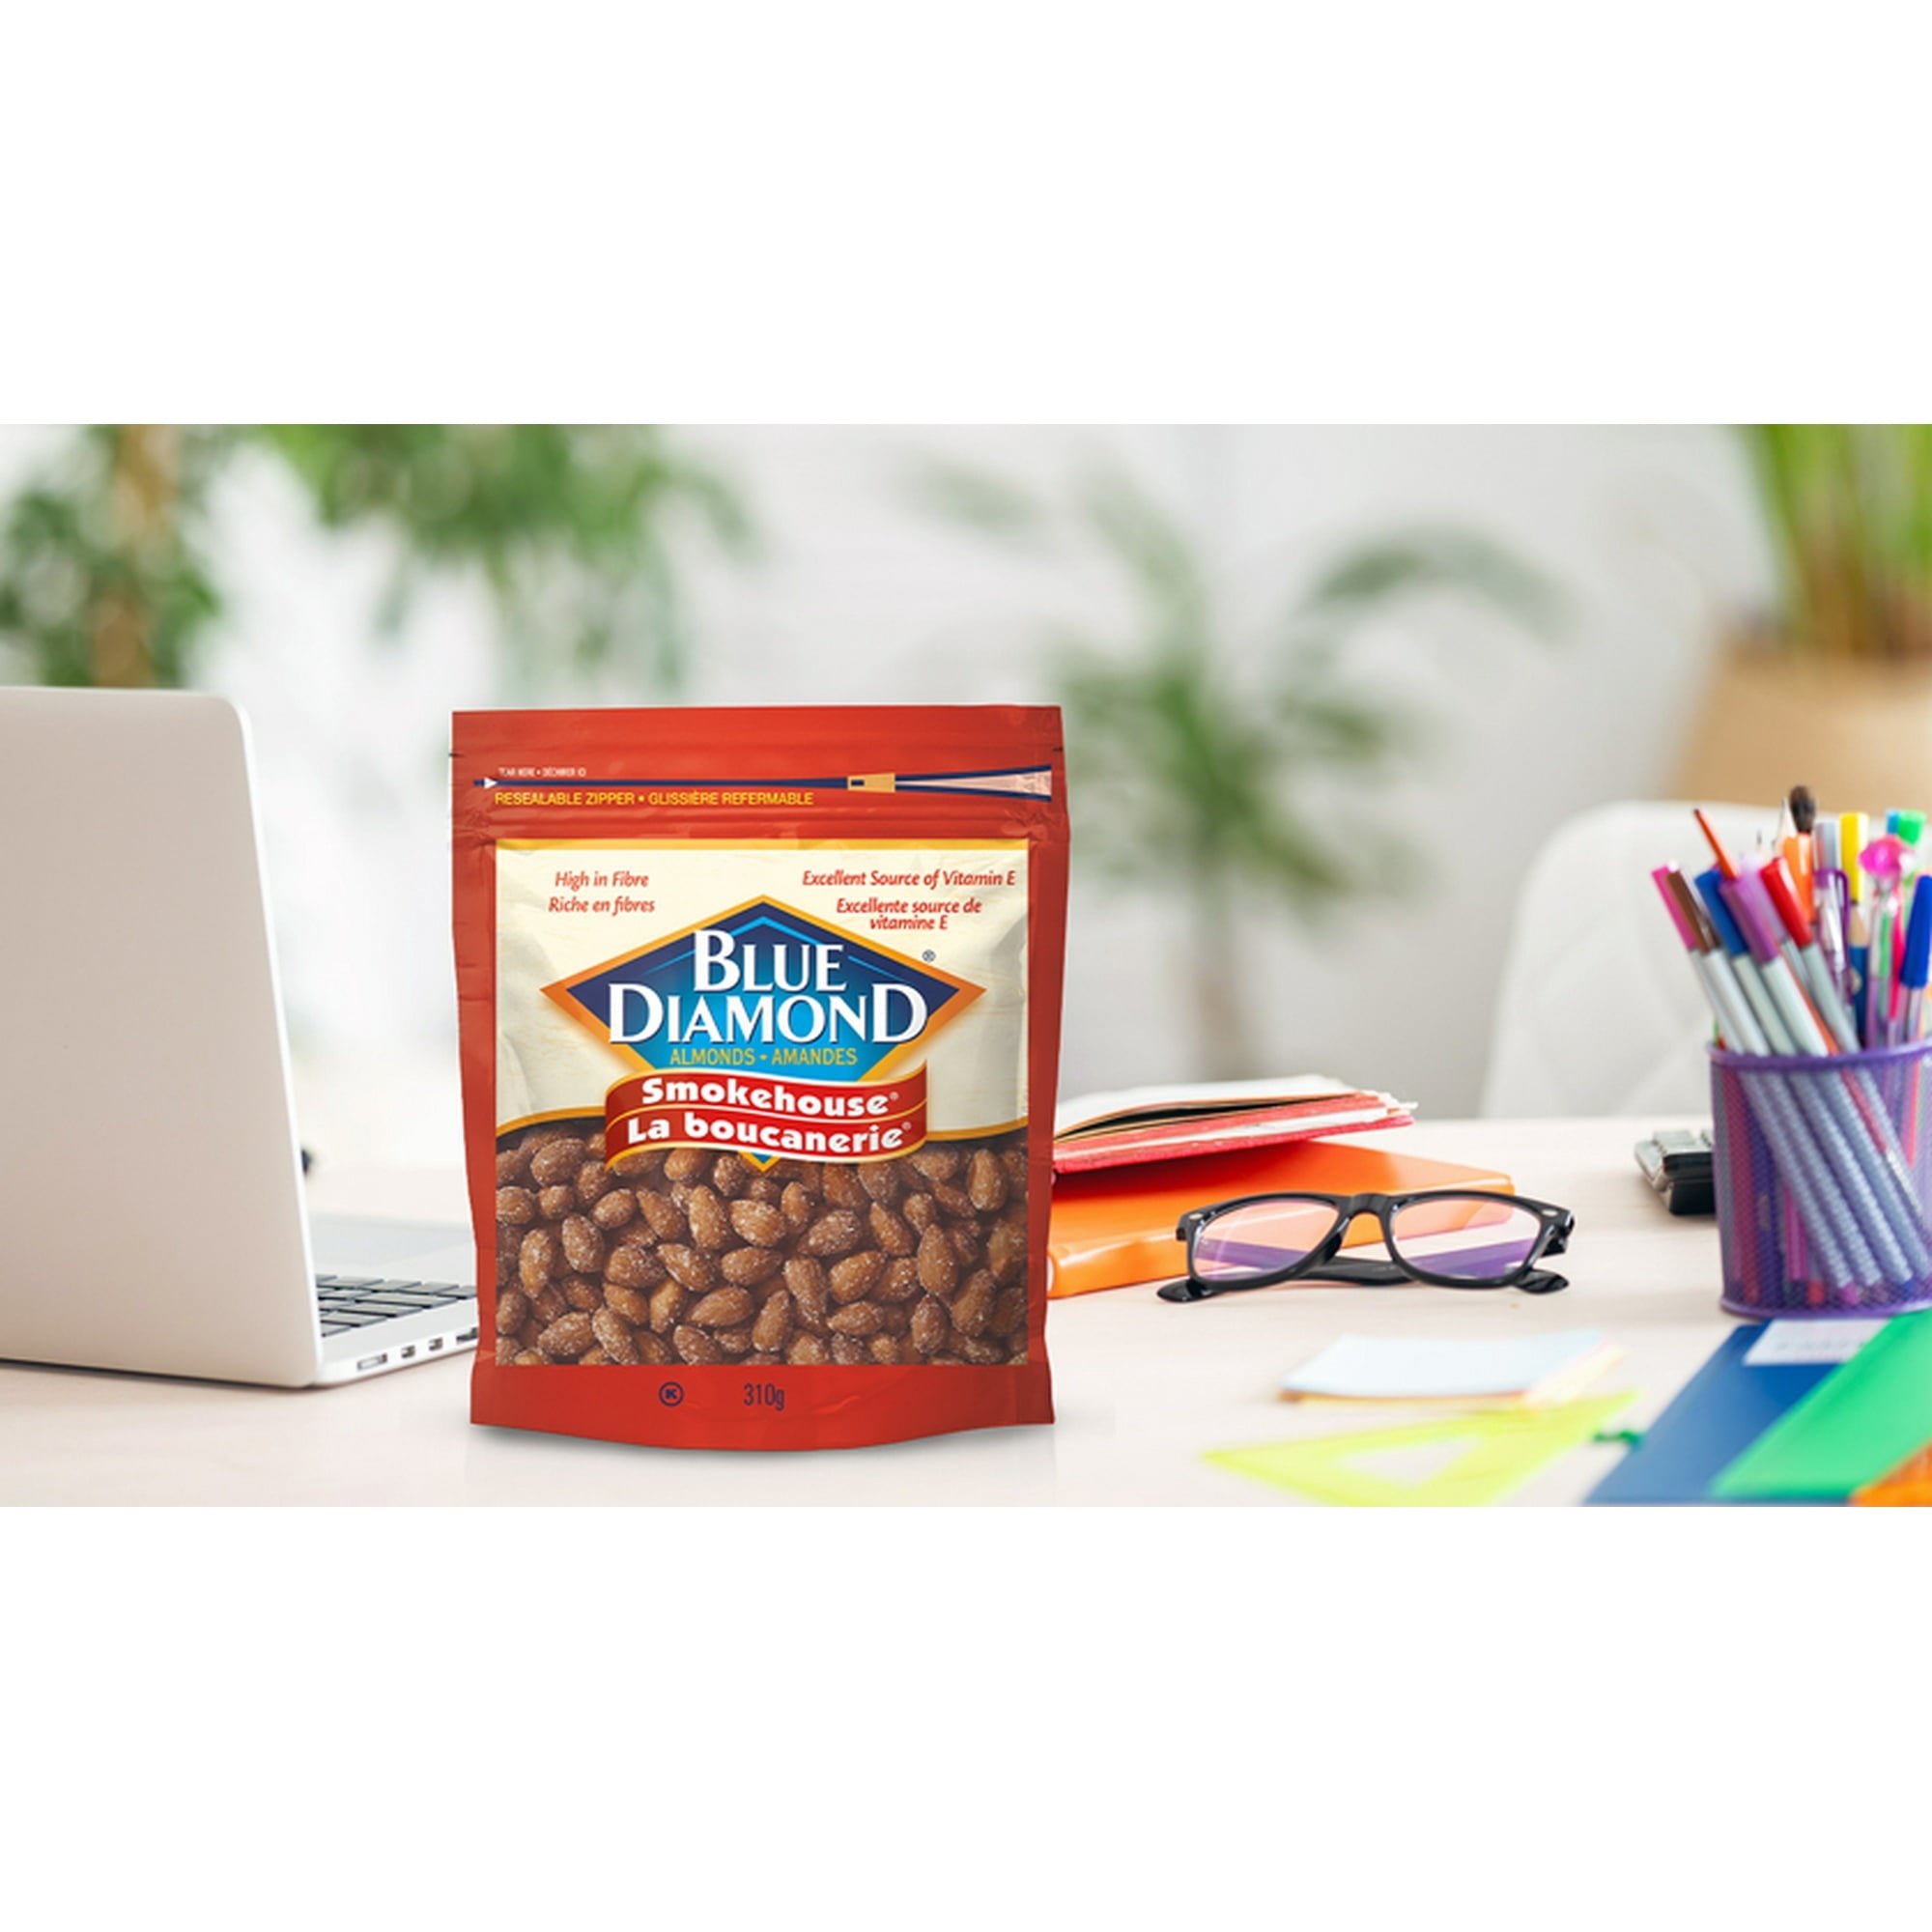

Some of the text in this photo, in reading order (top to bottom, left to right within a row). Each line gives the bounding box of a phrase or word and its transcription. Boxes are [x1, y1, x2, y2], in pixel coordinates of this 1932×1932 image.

[495, 789, 812, 805] RESEALABLE ZIPPER GLISSIÈRE REFERMABLE
[554, 870, 649, 892] High in Fibre
[802, 869, 1016, 890] Excellent Source of Vitamin E
[548, 895, 656, 917] Riche en fibres
[837, 897, 981, 914] Excellente source de
[869, 915, 949, 930] vitamine E
[694, 929, 847, 992] BLUE
[609, 983, 927, 1043] DIAMOND
[669, 1048, 858, 1065] ALMONDS AMANDES
[628, 1117, 670, 1145] La
[743, 1382, 785, 1411] 310g
